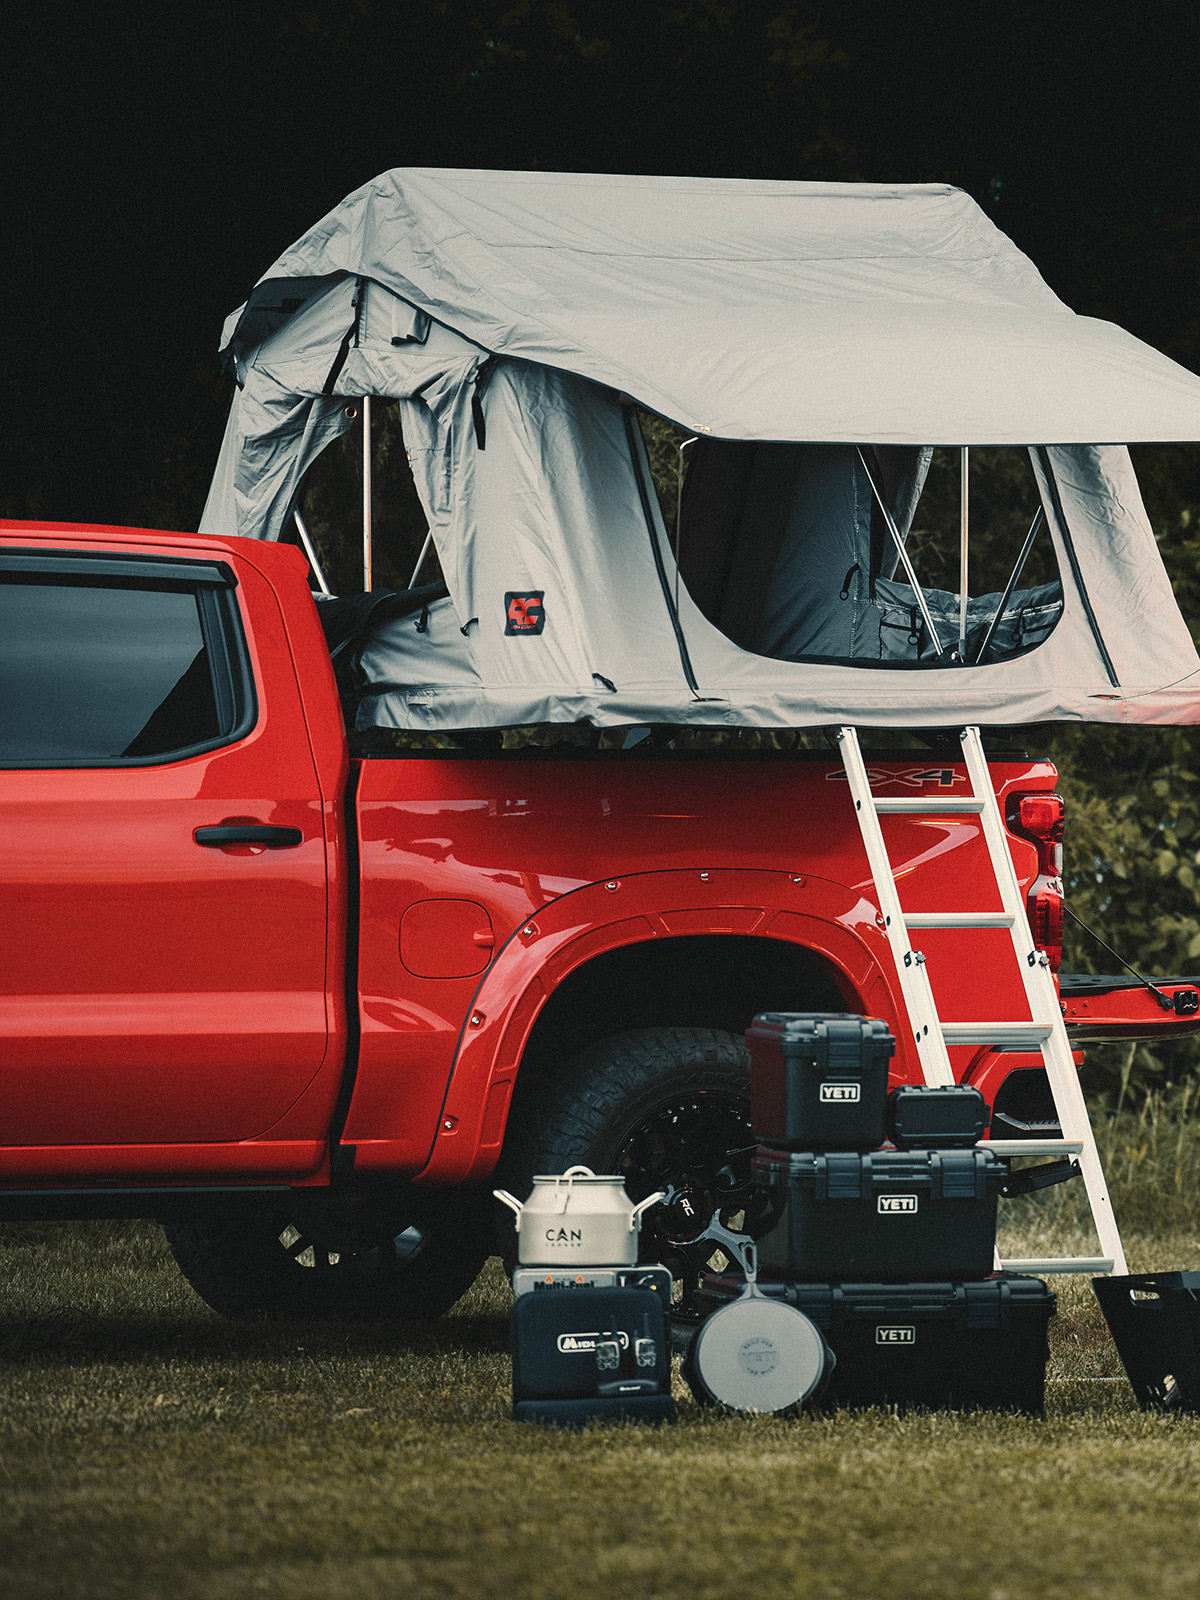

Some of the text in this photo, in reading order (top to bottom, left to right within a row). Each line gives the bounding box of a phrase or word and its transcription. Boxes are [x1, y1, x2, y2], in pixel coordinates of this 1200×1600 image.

[823, 1086, 857, 1099] YETI
[680, 1198, 695, 1217] RC
[881, 1198, 914, 1210] YETI
[545, 1228, 582, 1242] CAN
[879, 1329, 912, 1341] YETI
